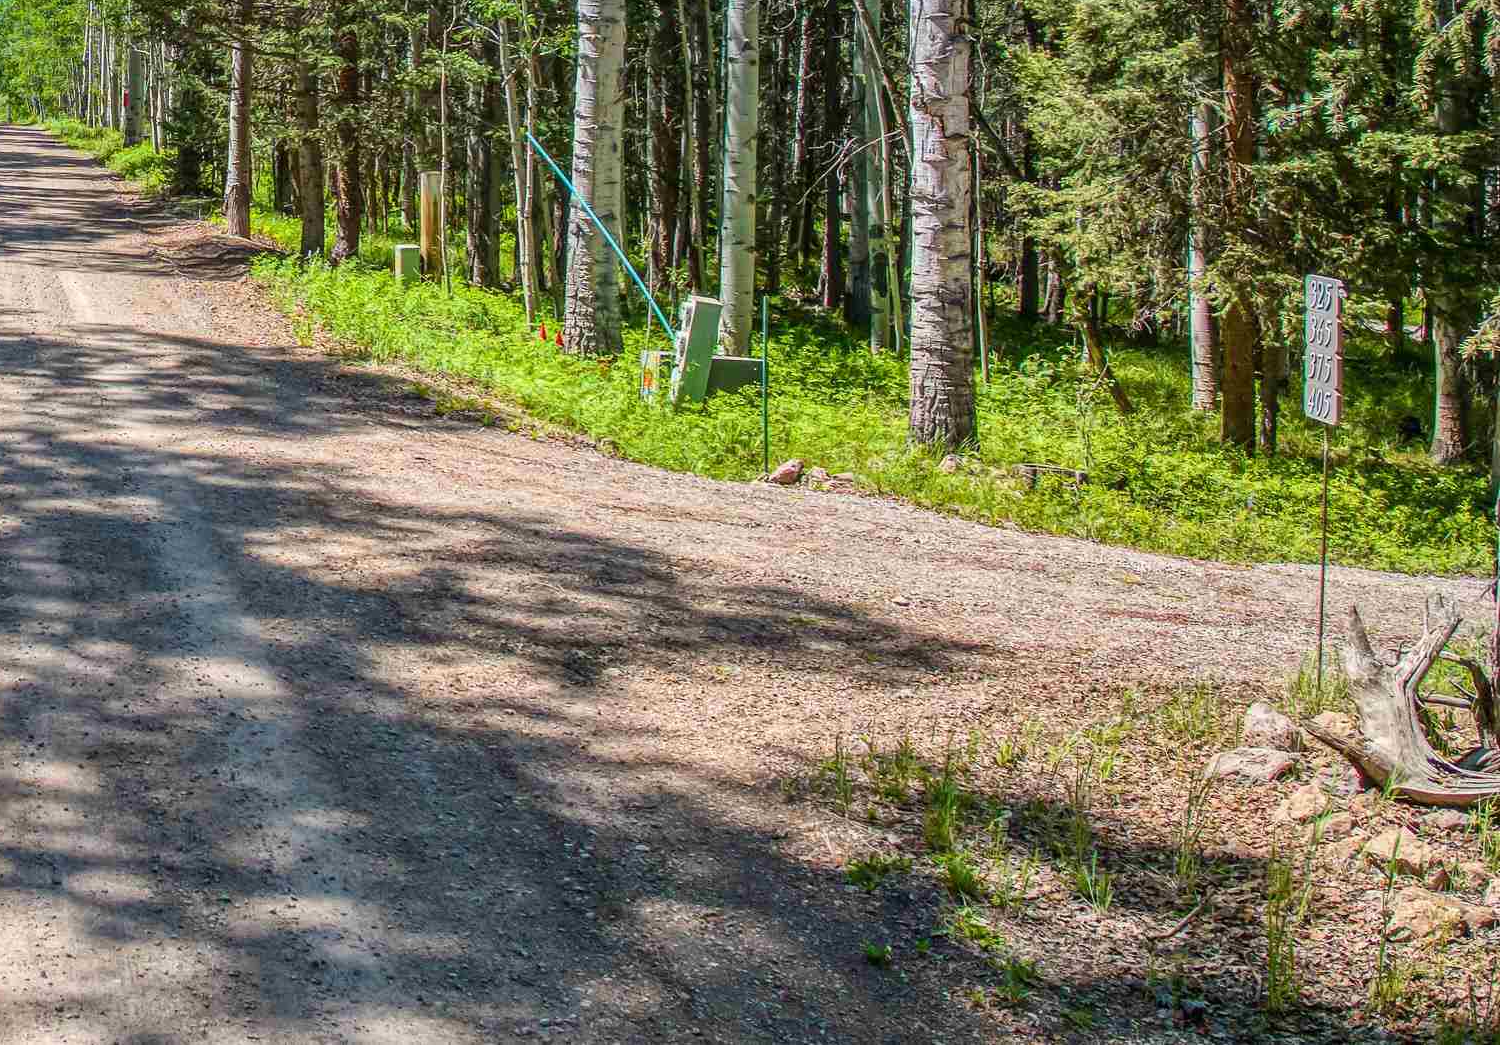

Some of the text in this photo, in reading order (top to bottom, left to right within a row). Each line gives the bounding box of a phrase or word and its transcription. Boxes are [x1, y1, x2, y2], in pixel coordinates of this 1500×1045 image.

[1310, 280, 1333, 311] 325
[1309, 315, 1332, 346] 365
[1308, 352, 1332, 383] 375
[1308, 388, 1331, 419] 405
